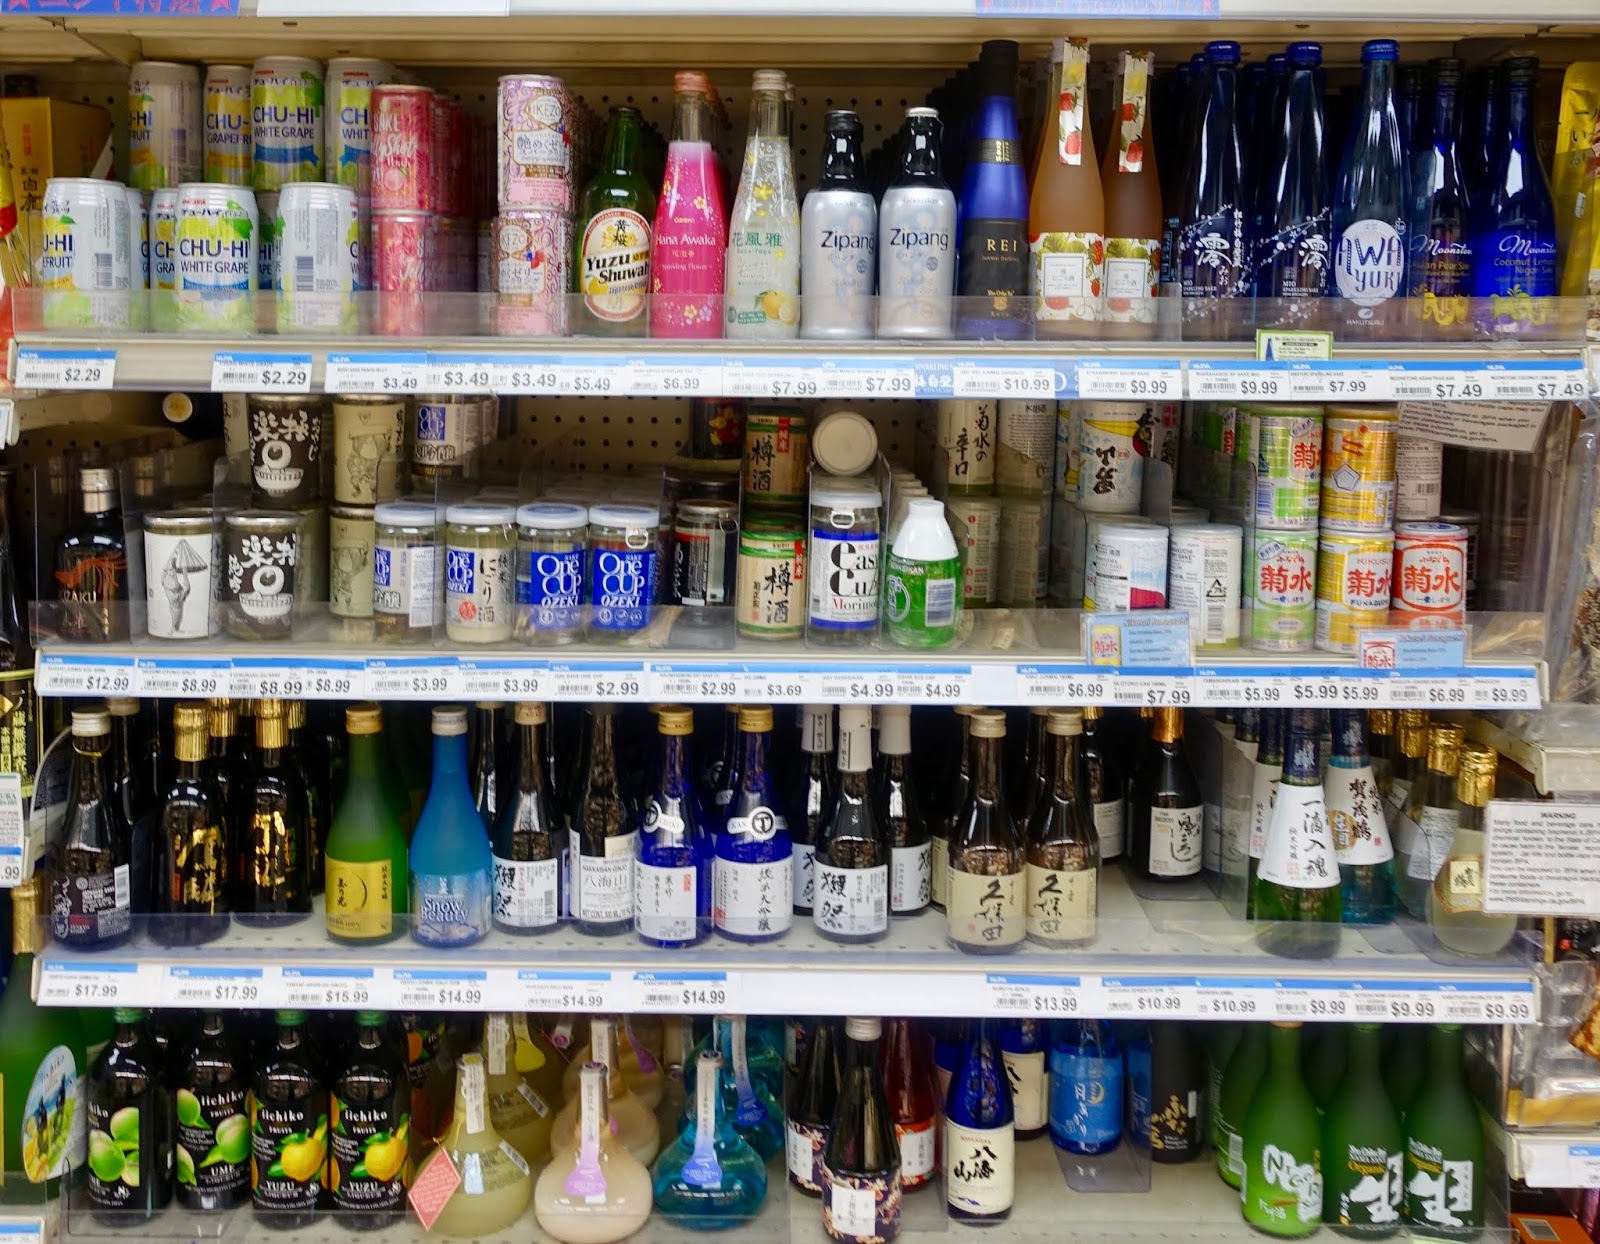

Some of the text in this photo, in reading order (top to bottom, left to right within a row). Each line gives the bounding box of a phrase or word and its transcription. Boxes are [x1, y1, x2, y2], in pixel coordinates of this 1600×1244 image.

[206, 113, 249, 130] CHU-
[253, 106, 314, 124] CHU-HI
[254, 128, 314, 140] WHITE GRAPE
[342, 129, 369, 140] WHIT
[656, 233, 717, 246] Hana Awaka
[732, 231, 783, 247] 花風雅
[821, 231, 875, 254] Zipang
[890, 228, 949, 251] Zipang
[987, 239, 1018, 252] REI
[179, 239, 249, 258] CHU-HI
[180, 261, 213, 273] WHITE
[214, 261, 249, 274] GRAPE
[587, 253, 631, 271] Yuzu
[65, 369, 100, 381] $2.29
[262, 371, 306, 384] $2.29
[445, 371, 490, 386] $3.49
[512, 373, 556, 388] $3.49
[384, 378, 417, 388] $3.49
[574, 378, 610, 391] $5.49
[664, 378, 699, 389] $6.99
[772, 382, 818, 396] $7.99
[866, 378, 911, 392] $7.99
[1004, 378, 1049, 390] $10.99
[1131, 380, 1167, 393] $9.99
[1241, 381, 1277, 394] $9.99
[1330, 381, 1366, 392] $7.99
[1435, 384, 1483, 399] $7.49
[1537, 383, 1585, 398] $7.49
[752, 435, 775, 491] 樽酒
[447, 551, 470, 568] One
[537, 555, 580, 577] One
[599, 552, 643, 575] One
[542, 573, 582, 597] CUP
[602, 573, 646, 597] CUP
[1261, 565, 1312, 594] 菊水
[1404, 565, 1461, 594] 菊水
[764, 561, 793, 625] 樽酒
[541, 595, 579, 609] OZEKI
[600, 594, 641, 608] OZEKI
[87, 677, 128, 690] $12.99
[182, 679, 216, 692] $8.99
[259, 682, 302, 696] $8.99
[316, 679, 350, 692] $8.99
[413, 678, 447, 692] $3.99
[504, 679, 538, 693] $3.99
[597, 682, 638, 695] $2.99
[702, 682, 735, 695] $2.99
[768, 685, 801, 696] $3.69
[851, 684, 893, 697] $4.99
[926, 684, 960, 697] $4.99
[1069, 684, 1103, 697] $6.99
[1146, 690, 1192, 705] $7.99
[1245, 687, 1279, 701] $5.99
[1295, 685, 1337, 699] $5.99
[1343, 686, 1378, 700] $5.99
[1429, 689, 1464, 702] $6.99
[1492, 688, 1527, 702] $9.99
[425, 897, 462, 912] Snow
[420, 907, 468, 924] Beauty
[75, 984, 117, 996] $17.99
[216, 985, 257, 1000] $17.99
[326, 991, 368, 1003] $15.99
[439, 990, 481, 1003] $14.99
[683, 990, 725, 1004] $14.99
[562, 995, 602, 1007] $14.99
[1035, 996, 1077, 1011] $13.99
[1138, 997, 1180, 1009] $10.99
[1213, 1000, 1255, 1012] $10.99
[1311, 1000, 1345, 1014] $9.99
[1391, 1002, 1434, 1016] $9.99
[1486, 1004, 1529, 1019] $9.99
[201, 1090, 244, 1107] iichiko
[261, 1109, 304, 1123] iichiko
[344, 1109, 388, 1122] iichiko
